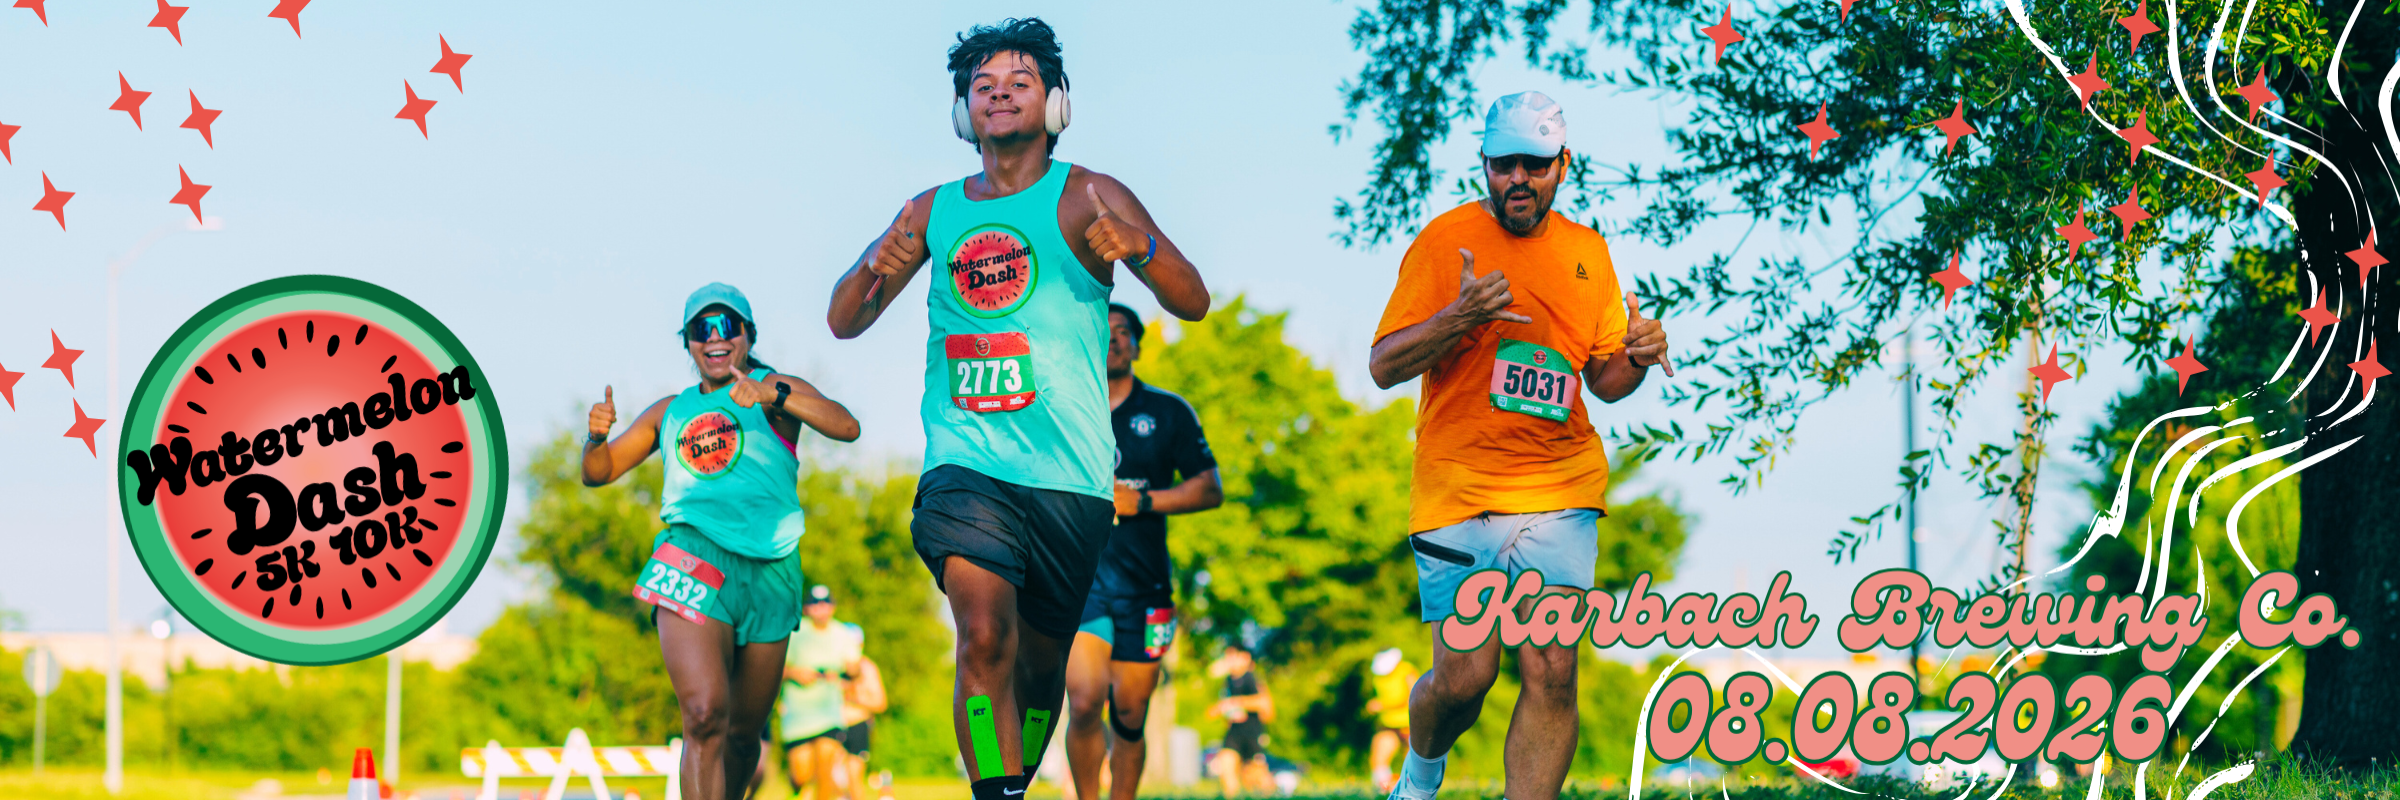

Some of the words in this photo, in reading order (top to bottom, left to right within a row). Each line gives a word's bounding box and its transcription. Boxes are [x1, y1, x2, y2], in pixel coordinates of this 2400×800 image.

[948, 245, 1031, 277] Watermelon
[967, 264, 1018, 291] Dash
[957, 358, 1022, 395] 2773
[1503, 363, 1567, 405] 5031
[677, 423, 739, 450] Watermelon
[690, 437, 727, 459] Dash
[645, 563, 707, 610] 2332
[973, 707, 986, 717] KT
[1031, 716, 1044, 724] KT
